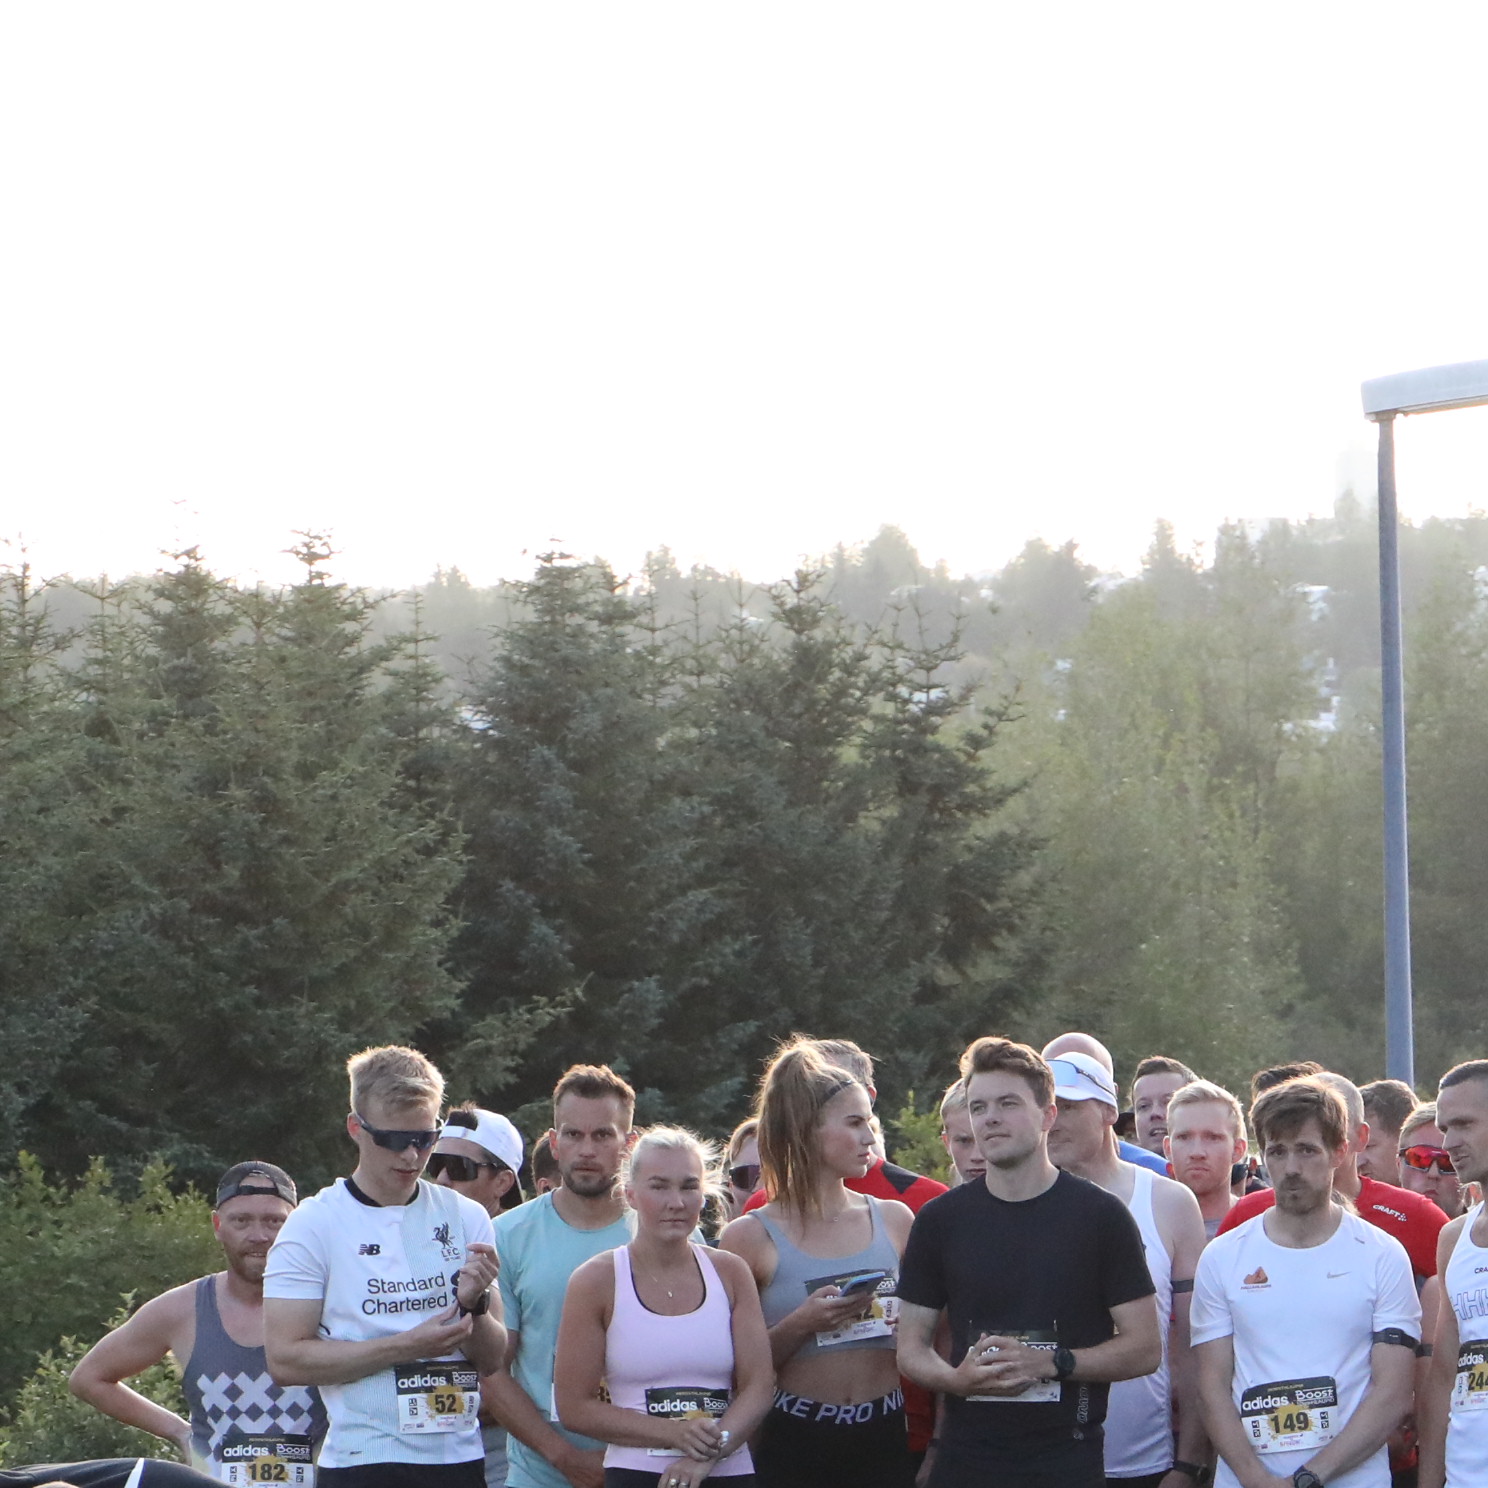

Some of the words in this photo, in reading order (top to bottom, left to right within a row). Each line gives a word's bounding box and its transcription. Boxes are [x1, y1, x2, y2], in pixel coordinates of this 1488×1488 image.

[367, 1272, 446, 1295] Standard
[362, 1292, 448, 1315] Chartered
[398, 1374, 447, 1388] adidas
[434, 1394, 457, 1413] 52
[649, 1399, 698, 1413] adidas
[1242, 1395, 1289, 1411] adidas
[1295, 1387, 1334, 1400] Boost
[815, 1402, 873, 1425] PRO
[1270, 1411, 1309, 1433] 149
[223, 1444, 269, 1457] adidas
[276, 1443, 310, 1454] Boost
[248, 1463, 286, 1481] 182
